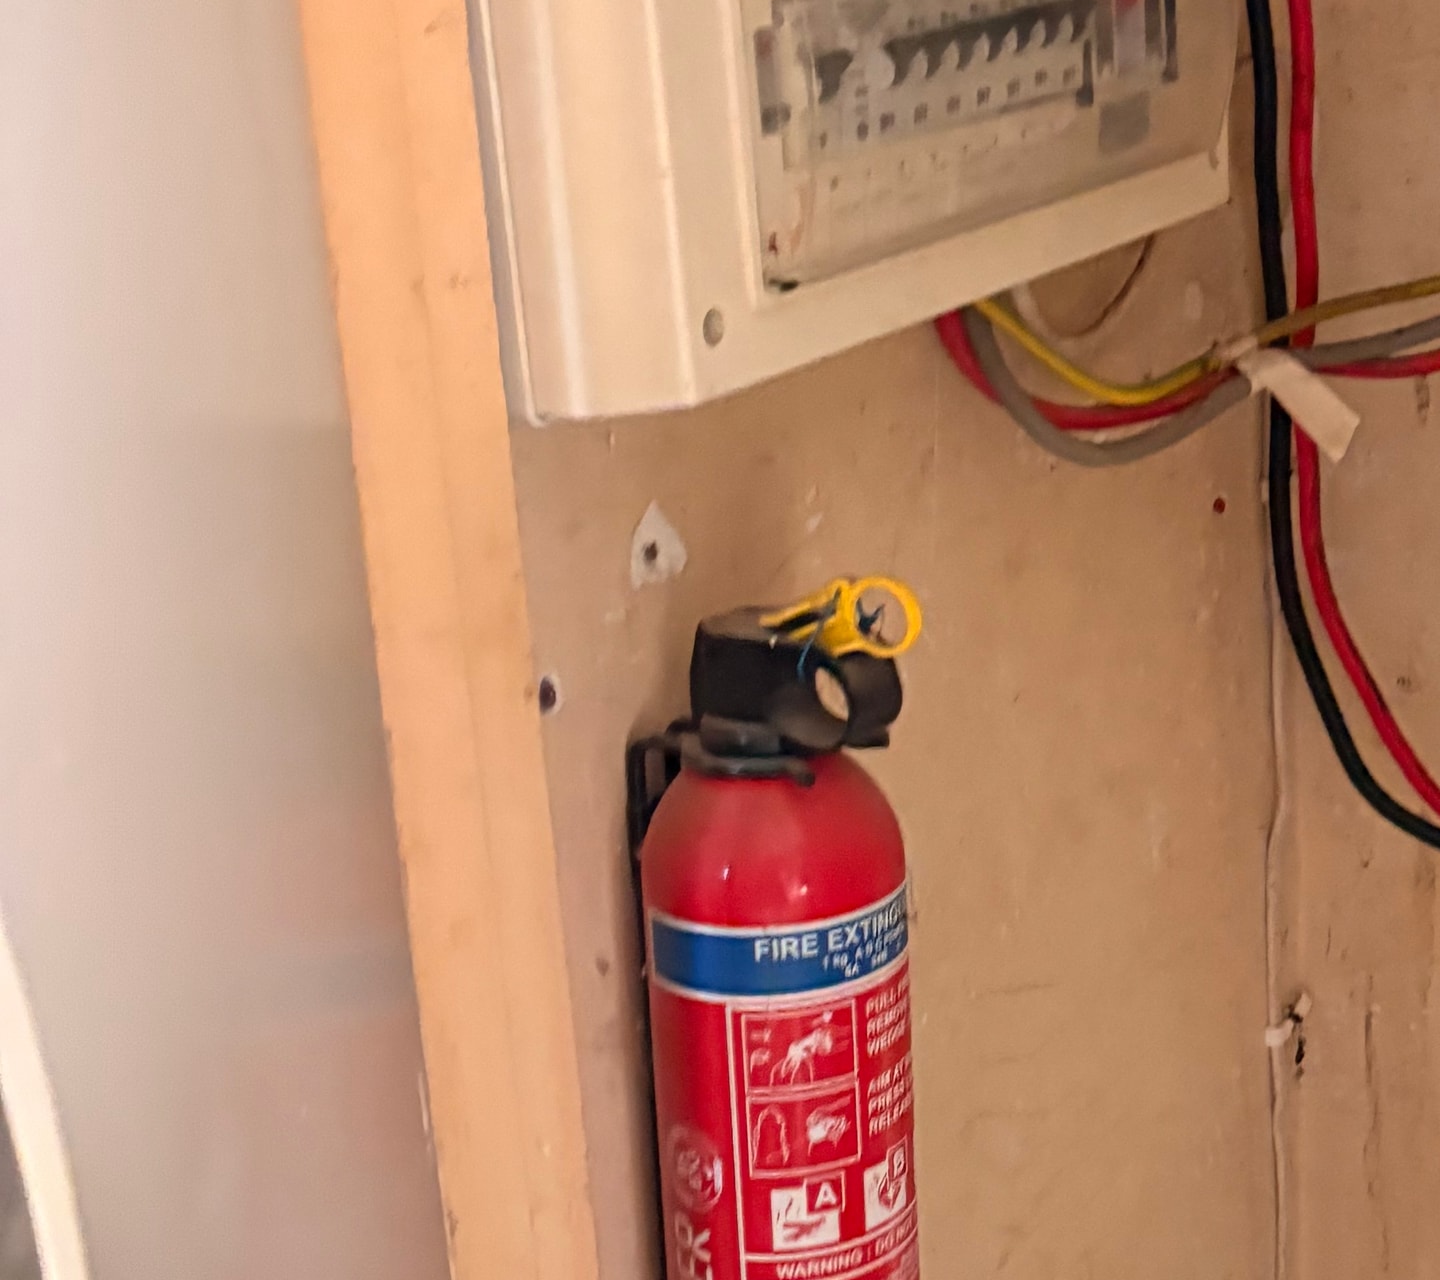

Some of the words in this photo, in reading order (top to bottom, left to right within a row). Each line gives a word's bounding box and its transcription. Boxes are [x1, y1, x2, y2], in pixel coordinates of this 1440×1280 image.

[753, 934, 818, 964] FIRE
[814, 1181, 838, 1209] A
[776, 1249, 863, 1280] WARNING
